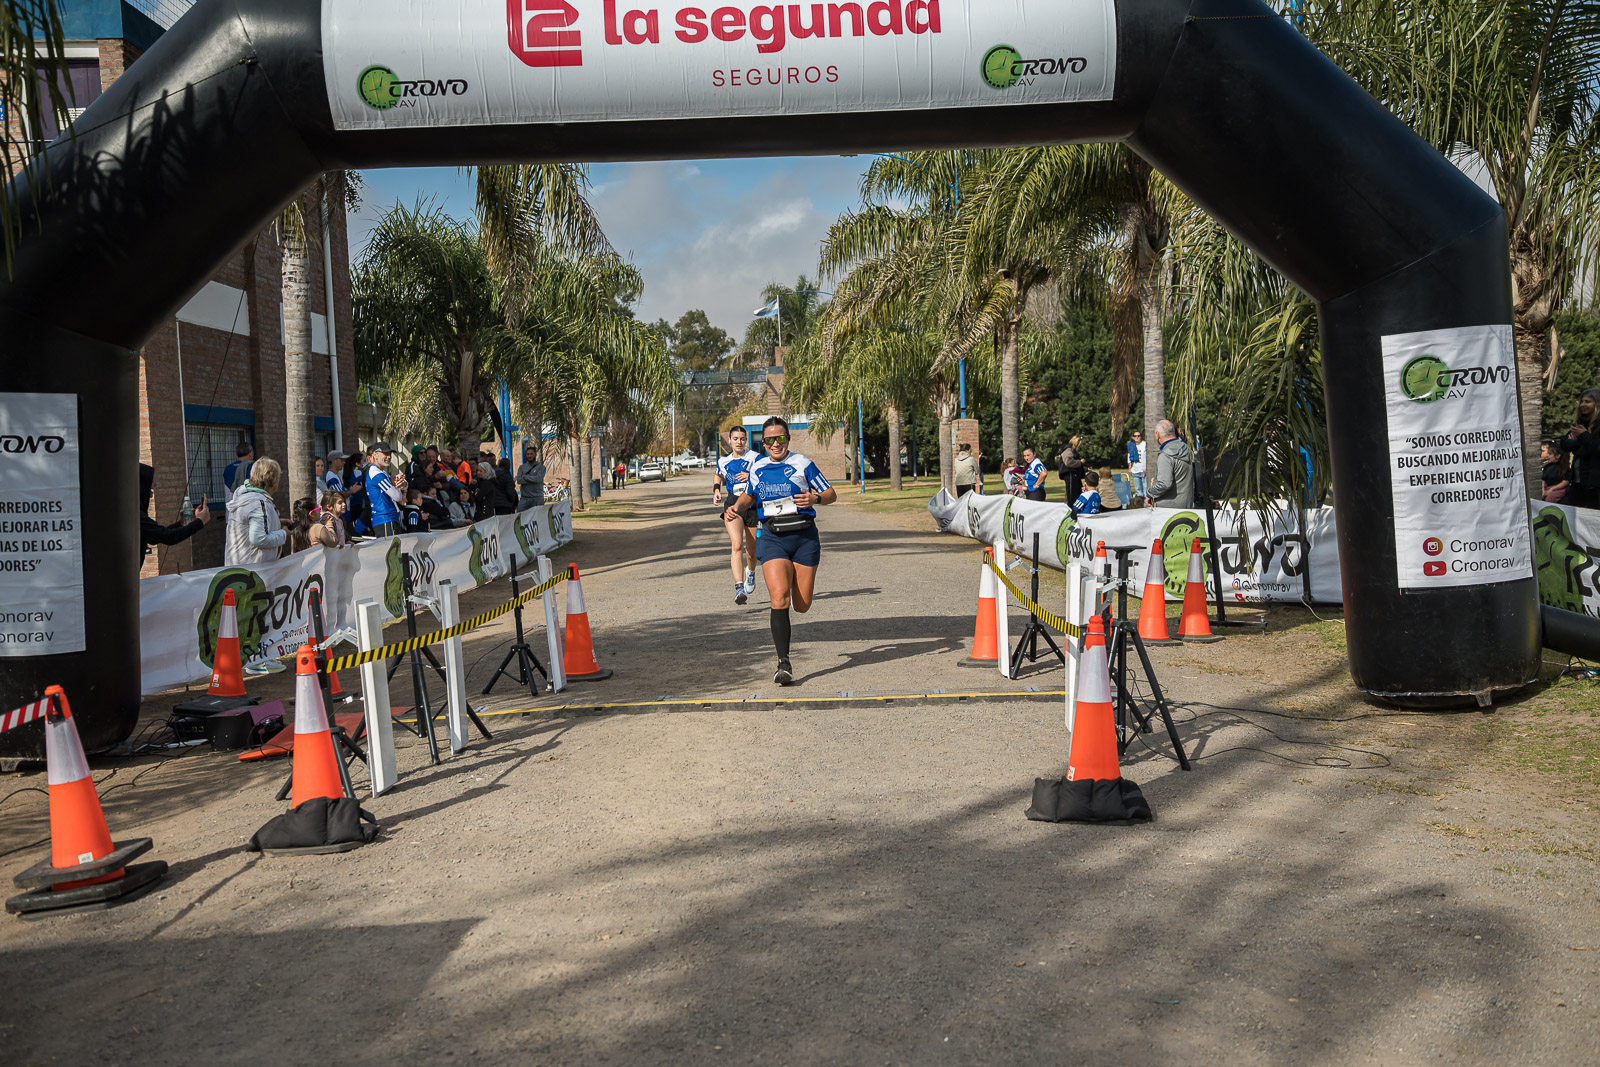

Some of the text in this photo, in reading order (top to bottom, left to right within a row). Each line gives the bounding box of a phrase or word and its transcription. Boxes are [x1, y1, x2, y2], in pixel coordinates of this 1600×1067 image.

[603, 0, 941, 53] la segunda
[1010, 57, 1087, 76] CRONO
[712, 65, 839, 87] SEGUROS
[1008, 78, 1036, 88] RAV
[388, 79, 469, 98] CRONO
[388, 99, 417, 108] RAV
[1437, 365, 1509, 387] CRONO
[1435, 389, 1467, 400] RAV
[0, 435, 65, 453] ONO
[1405, 429, 1512, 449] “SOMOS CORREDORES
[1398, 447, 1519, 468] BUSCANDO MEJORAR LAS
[1410, 466, 1515, 487] EXPERIENCIAS DE LOS
[1431, 487, 1504, 504] CORREDORES”
[0, 519, 73, 533] EJORAR LAS
[22, 540, 38, 552] DE
[41, 539, 63, 551] LOS
[1450, 536, 1514, 553] Cronorav
[1451, 556, 1515, 573] Cronorav
